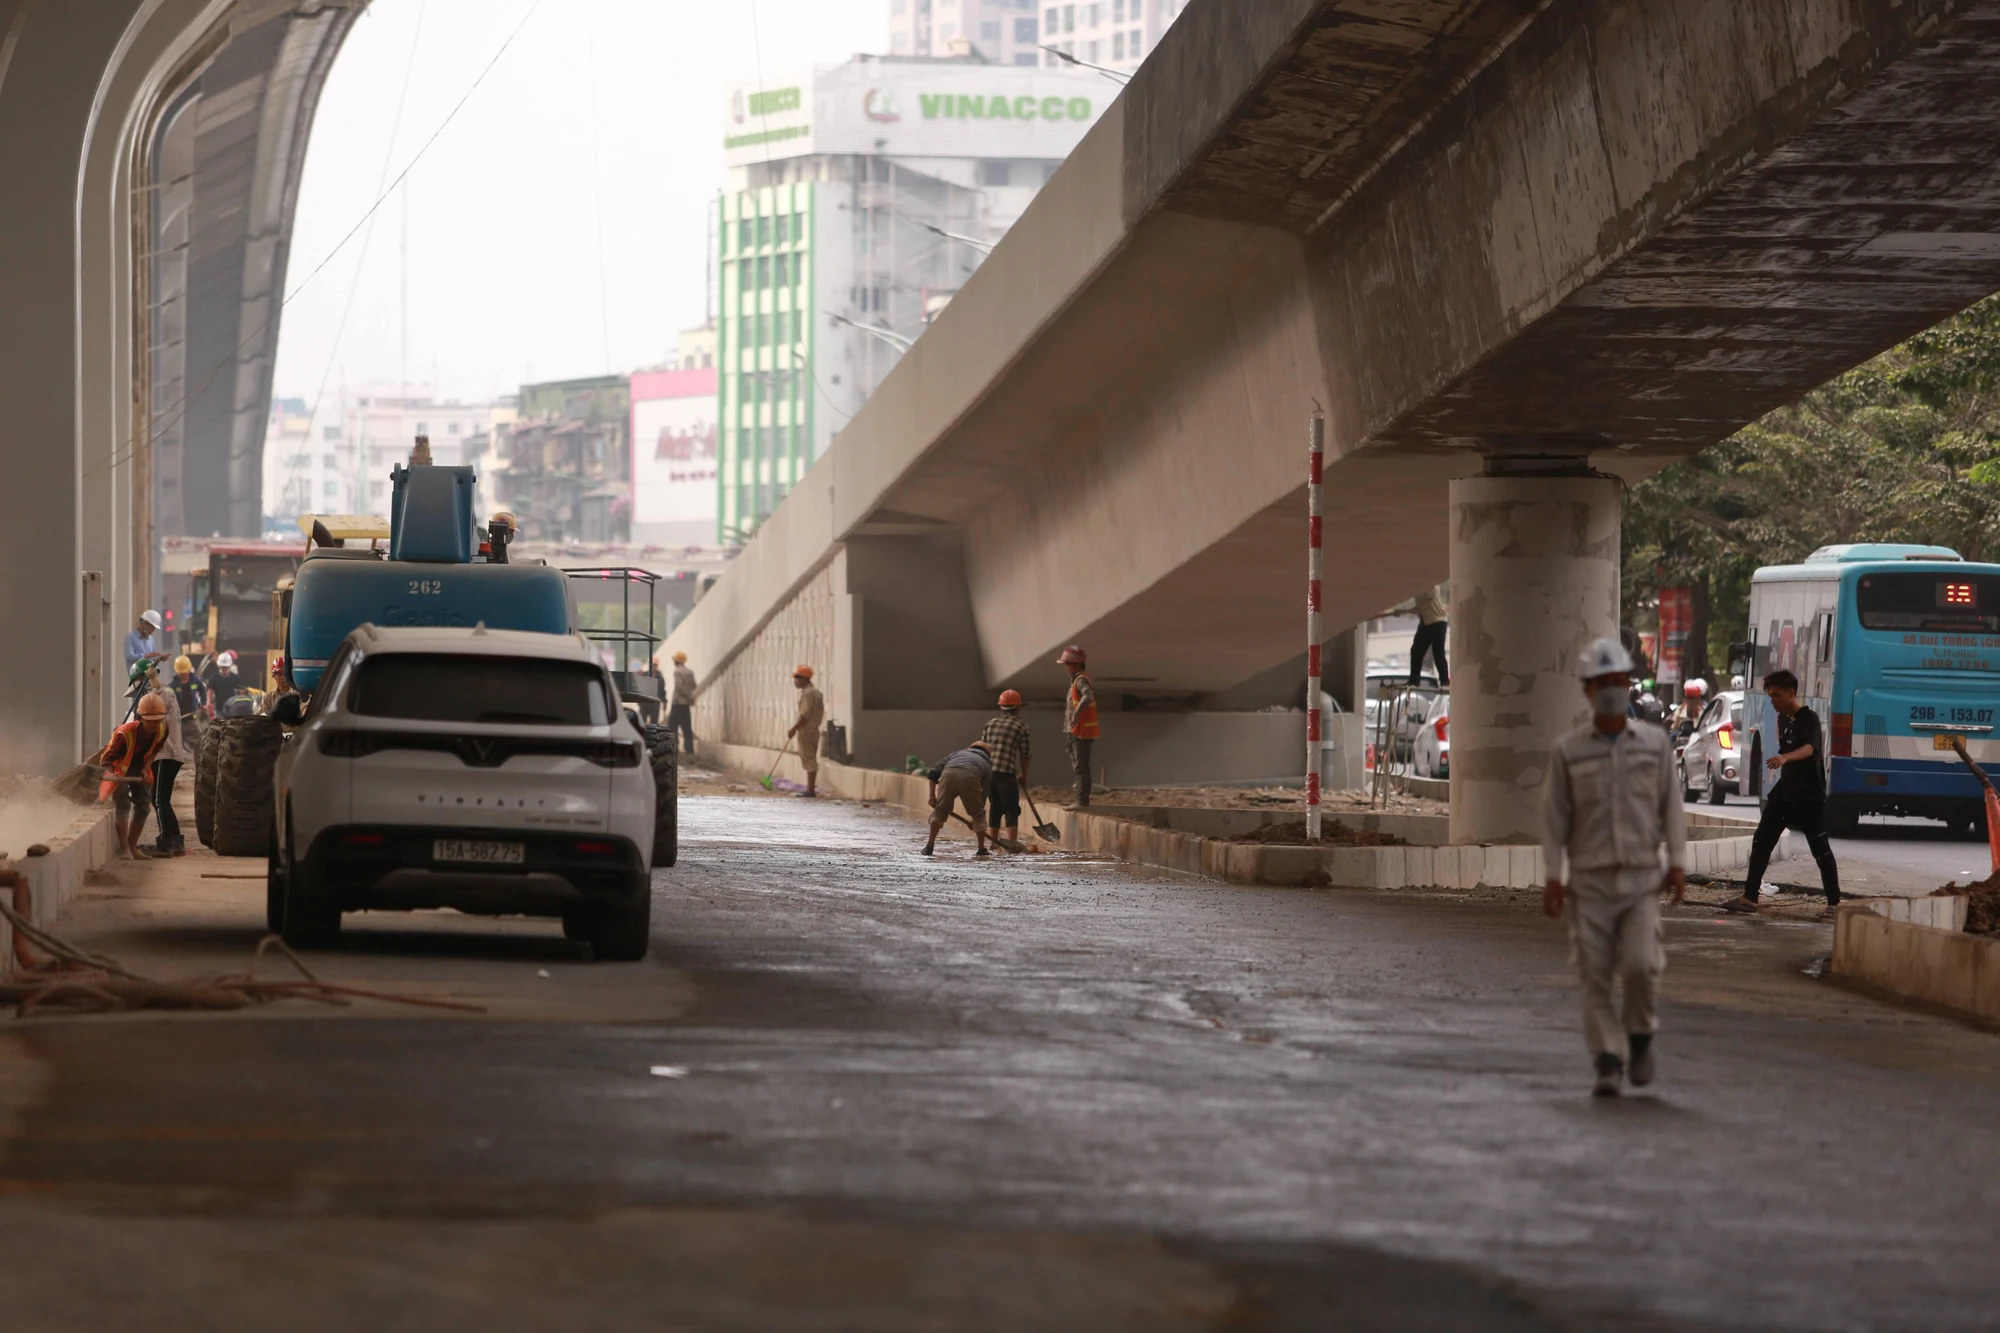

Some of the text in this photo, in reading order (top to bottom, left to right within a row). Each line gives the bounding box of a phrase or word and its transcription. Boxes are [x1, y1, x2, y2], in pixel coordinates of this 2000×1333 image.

[918, 93, 1092, 121] VINACCO
[408, 580, 442, 595] 262
[1910, 706, 1935, 720] 29B
[1950, 708, 1994, 723] 153.07
